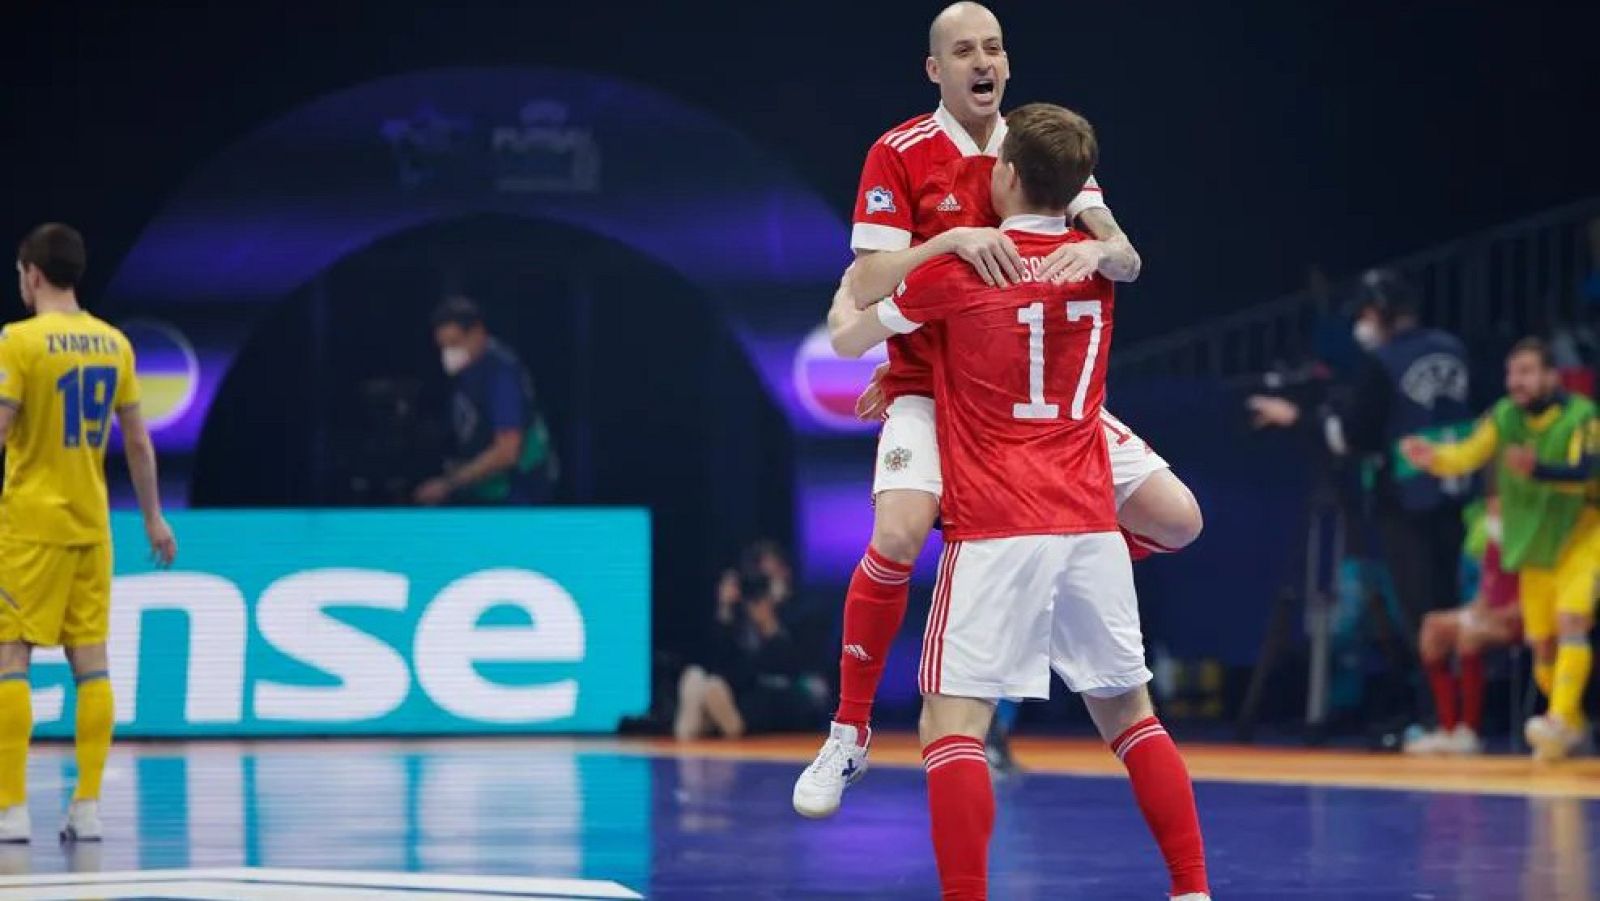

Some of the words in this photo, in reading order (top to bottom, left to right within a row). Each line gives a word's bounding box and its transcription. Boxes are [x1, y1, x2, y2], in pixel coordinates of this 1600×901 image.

[56, 364, 118, 449] 19
[1013, 300, 1103, 420] 17
[30, 567, 586, 724] nse
